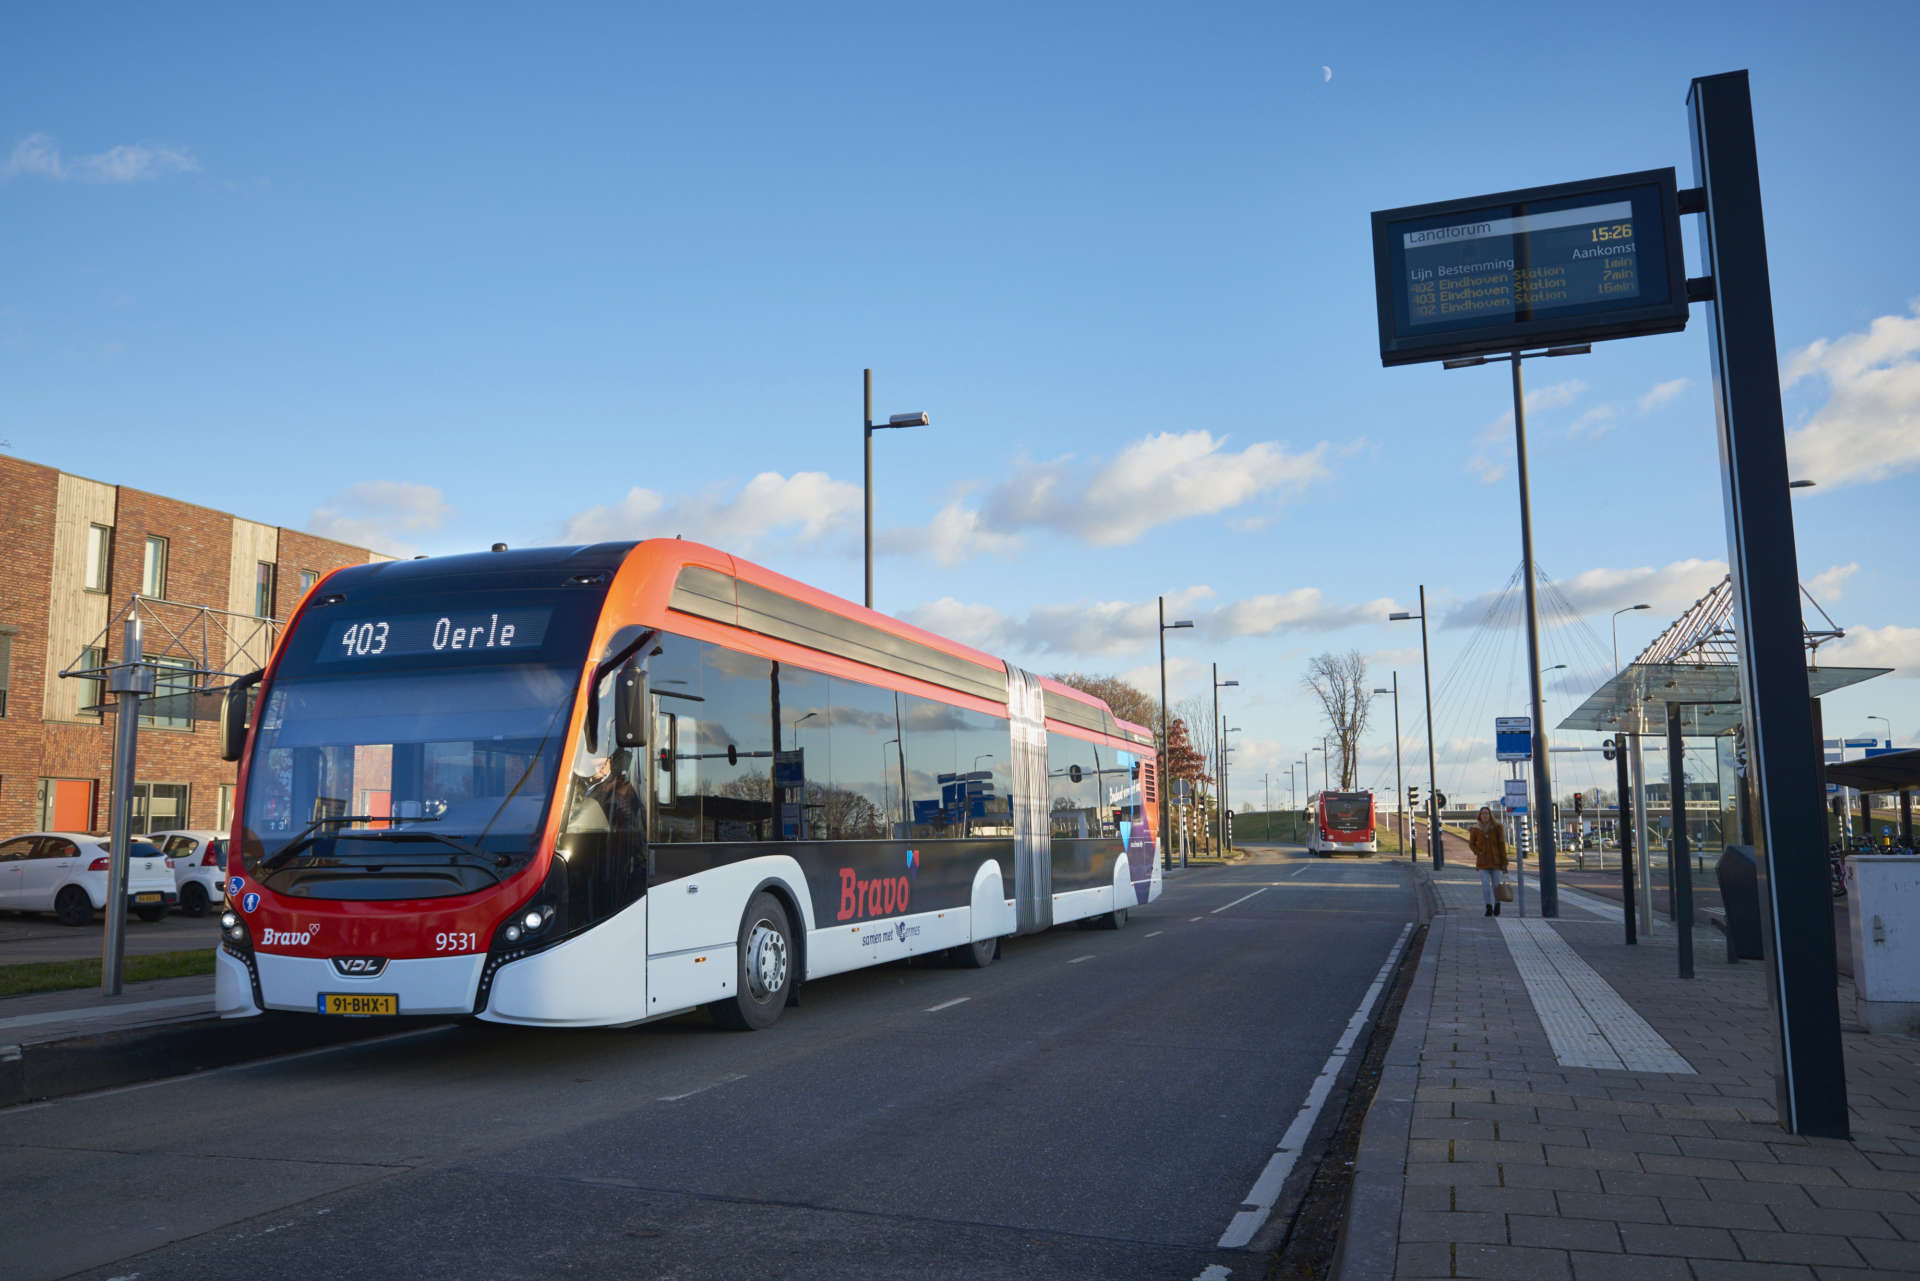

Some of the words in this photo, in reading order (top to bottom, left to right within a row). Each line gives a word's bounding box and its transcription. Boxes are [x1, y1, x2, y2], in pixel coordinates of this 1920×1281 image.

[1409, 223, 1491, 243] Landforum
[1592, 224, 1632, 242] 15:26
[1411, 268, 1432, 281] Lijn
[1438, 258, 1514, 276] Bestemming
[1573, 243, 1636, 259] Aankomst
[1440, 274, 1508, 290] Eindhoven
[1514, 266, 1565, 281] Station
[1440, 286, 1509, 302] Eindhoven
[1514, 278, 1566, 293] Station
[1441, 297, 1510, 313] Eindhoven
[343, 622, 389, 656] 403
[432, 614, 516, 650] Oerle
[837, 867, 909, 920] Bravo
[261, 928, 311, 946] Bravo
[436, 933, 476, 951] 9531
[338, 959, 378, 971] VDL
[333, 997, 389, 1013] 91-BHX-1
